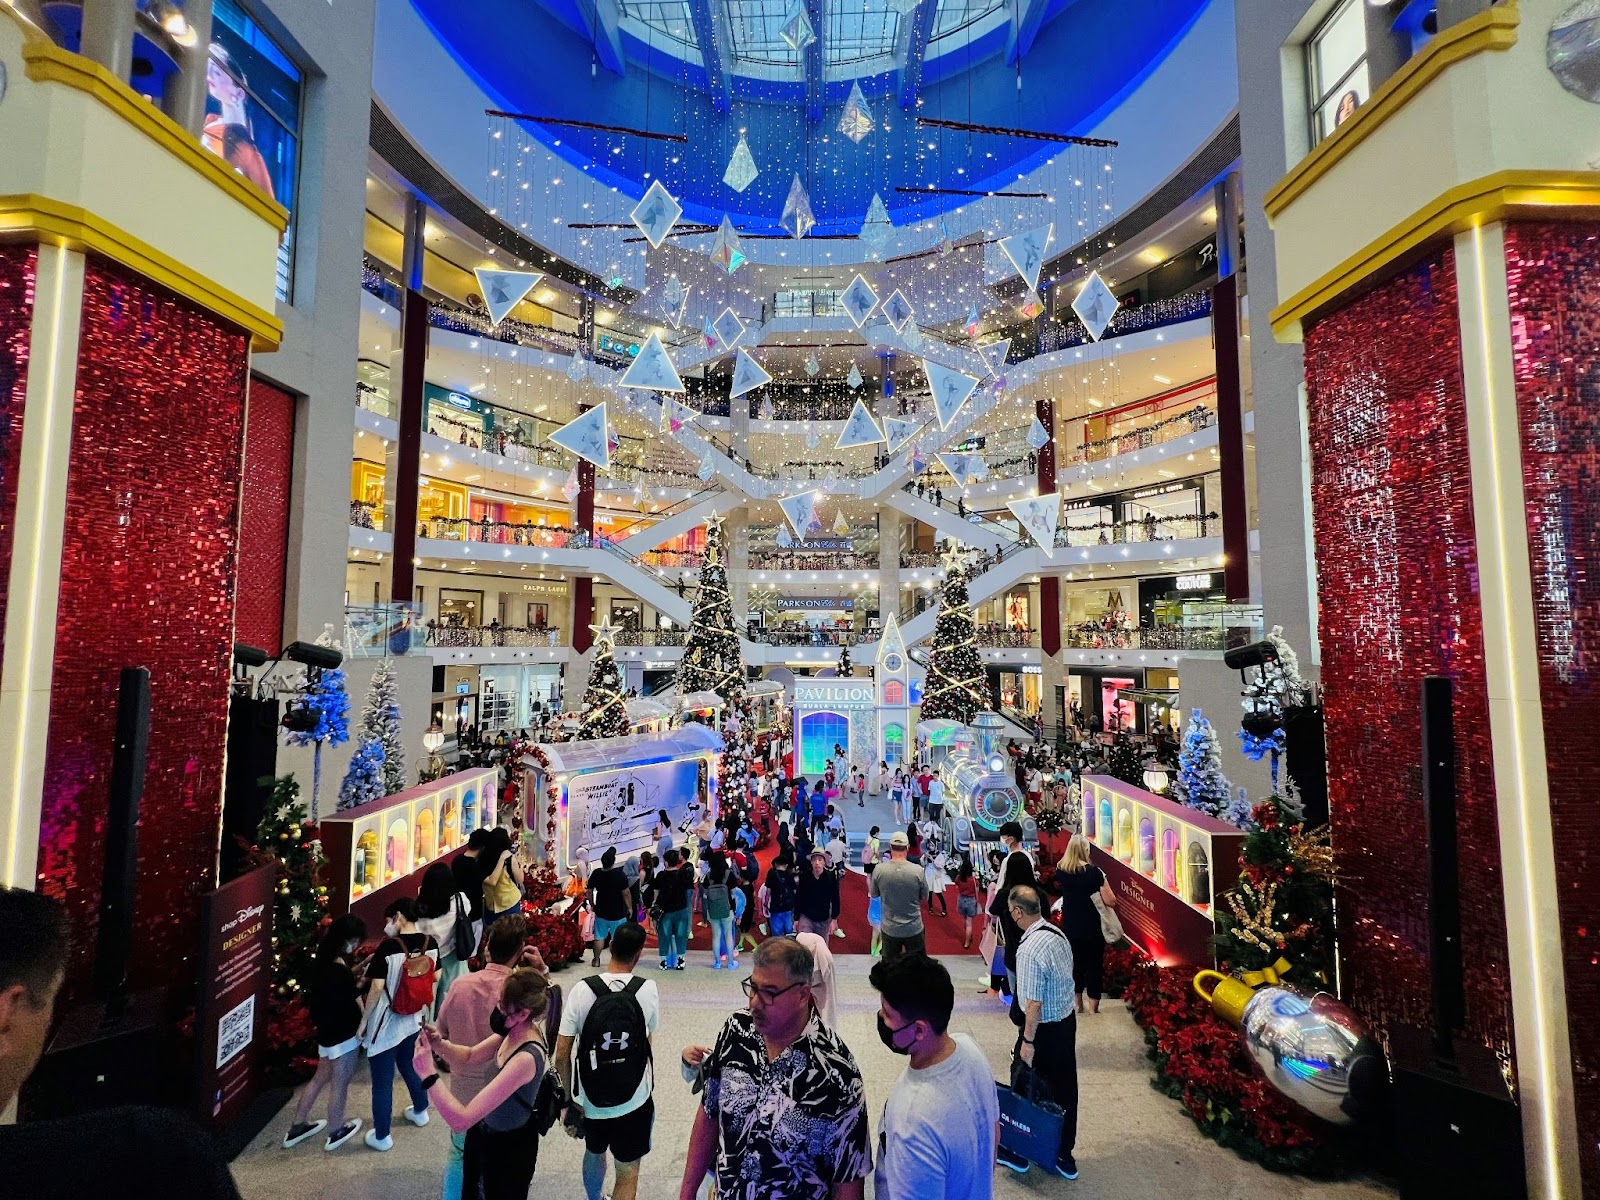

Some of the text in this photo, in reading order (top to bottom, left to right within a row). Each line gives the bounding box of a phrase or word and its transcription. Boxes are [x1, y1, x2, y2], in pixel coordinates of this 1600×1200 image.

[523, 584, 545, 592] RALPH
[778, 599, 820, 607] PARKSON
[1022, 666, 1042, 674] BOSS
[794, 687, 874, 700] PAVILION
[1120, 880, 1156, 912] DESIGNER
[220, 904, 265, 933] shop Disney
[222, 922, 262, 951] DESIGNER
